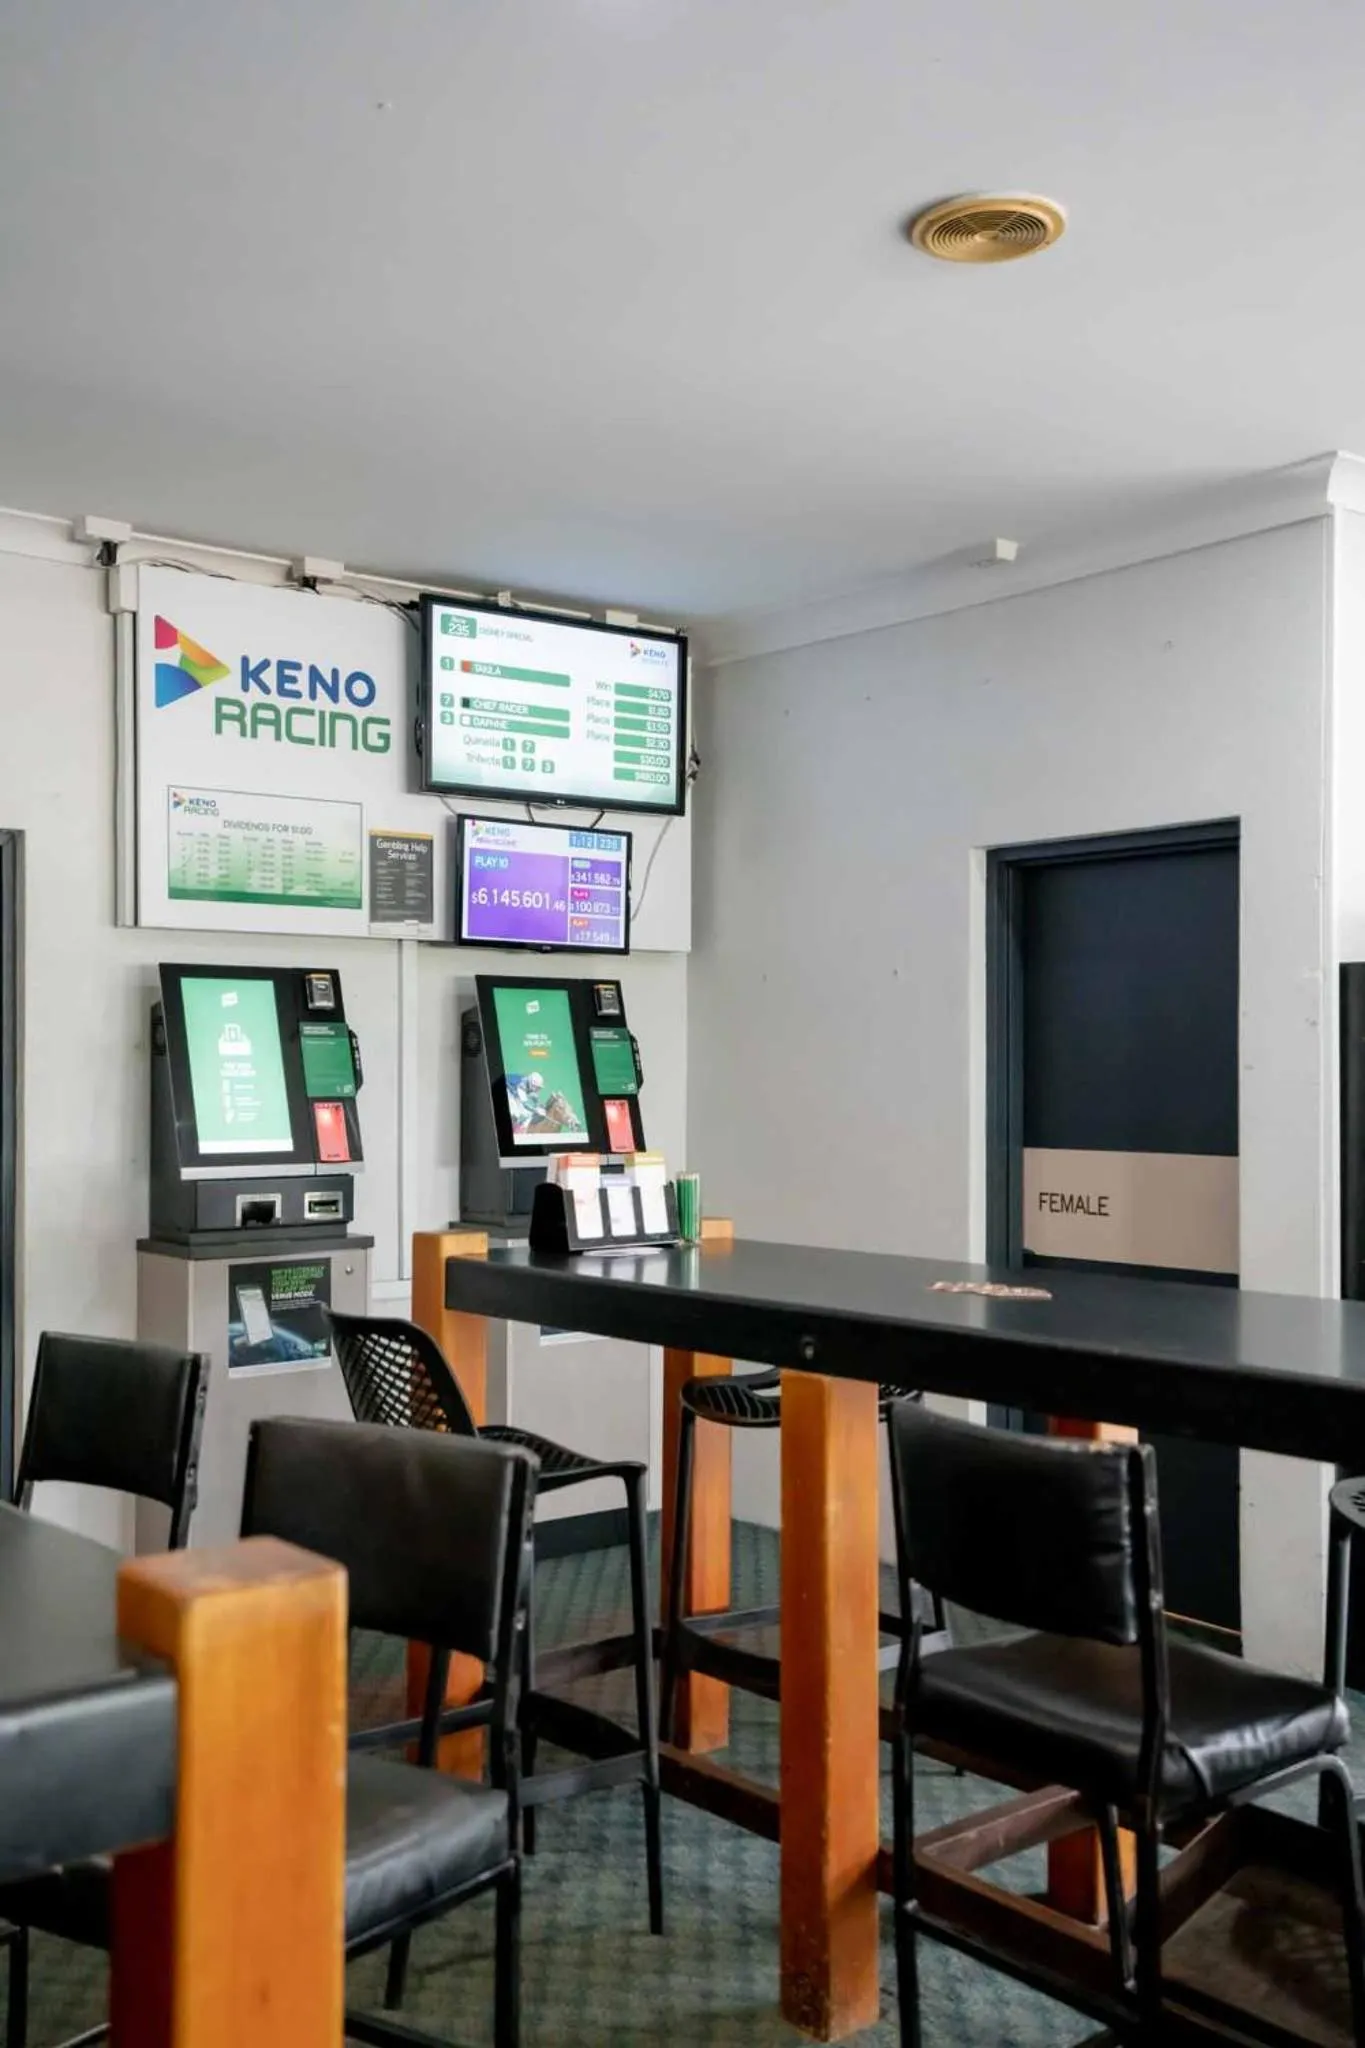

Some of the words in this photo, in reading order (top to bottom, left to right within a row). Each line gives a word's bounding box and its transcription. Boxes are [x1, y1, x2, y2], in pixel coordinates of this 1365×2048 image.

[448, 622, 469, 636] 235
[643, 649, 666, 659] KENO
[240, 654, 376, 708] KENO
[595, 680, 611, 691] Win
[586, 696, 610, 708] Place
[214, 696, 391, 754] RACING
[586, 713, 610, 725] Place
[586, 730, 610, 742] Place
[188, 798, 217, 808] KENO
[184, 806, 220, 817] RACING
[223, 820, 270, 832] DIVIDENDS
[272, 823, 290, 832] FOR
[376, 838, 410, 852] Gambling
[410, 842, 428, 854] Help
[388, 849, 417, 860] Services
[475, 856, 498, 868] PLAY
[499, 857, 509, 869] 10
[1039, 1192, 1109, 1216] FEMALE
